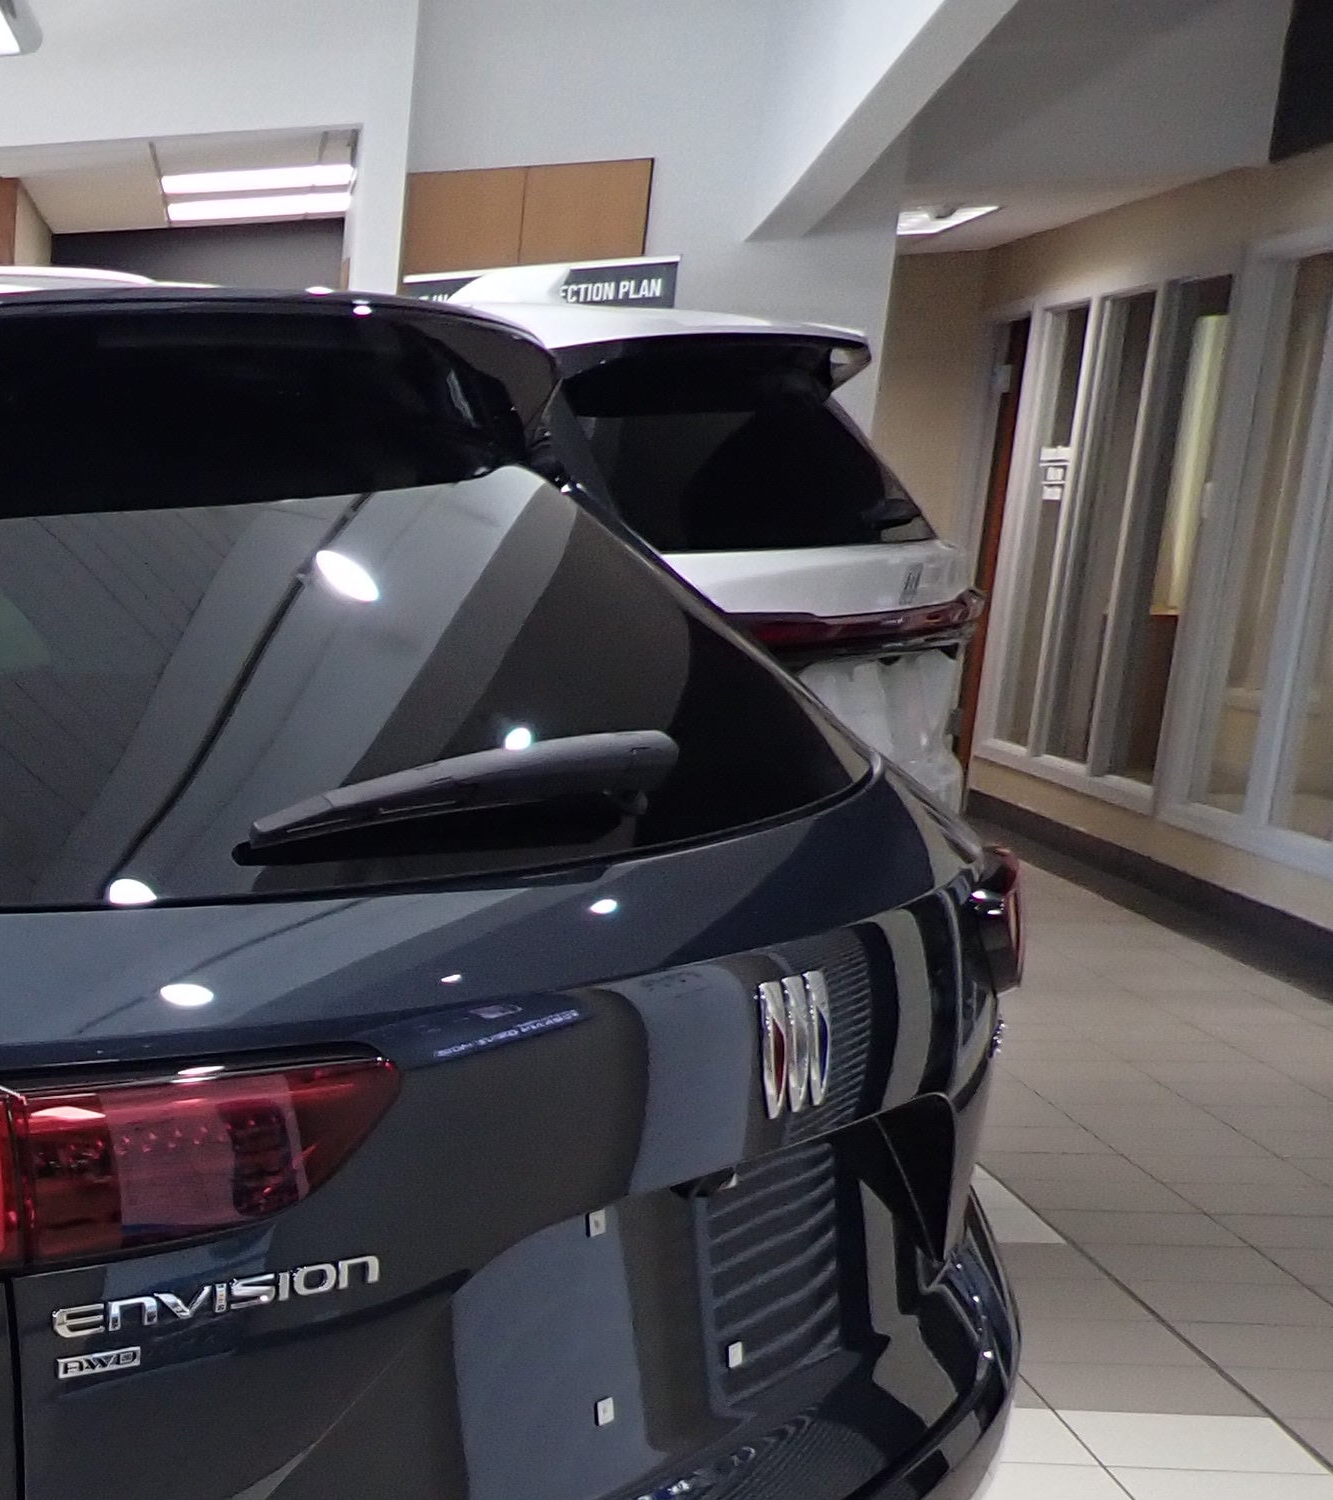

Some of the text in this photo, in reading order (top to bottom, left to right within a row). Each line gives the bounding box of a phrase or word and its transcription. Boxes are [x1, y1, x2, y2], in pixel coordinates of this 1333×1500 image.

[618, 279, 662, 300] PLAN
[51, 1254, 380, 1340] ENVISION
[61, 1350, 138, 1377] AWD
